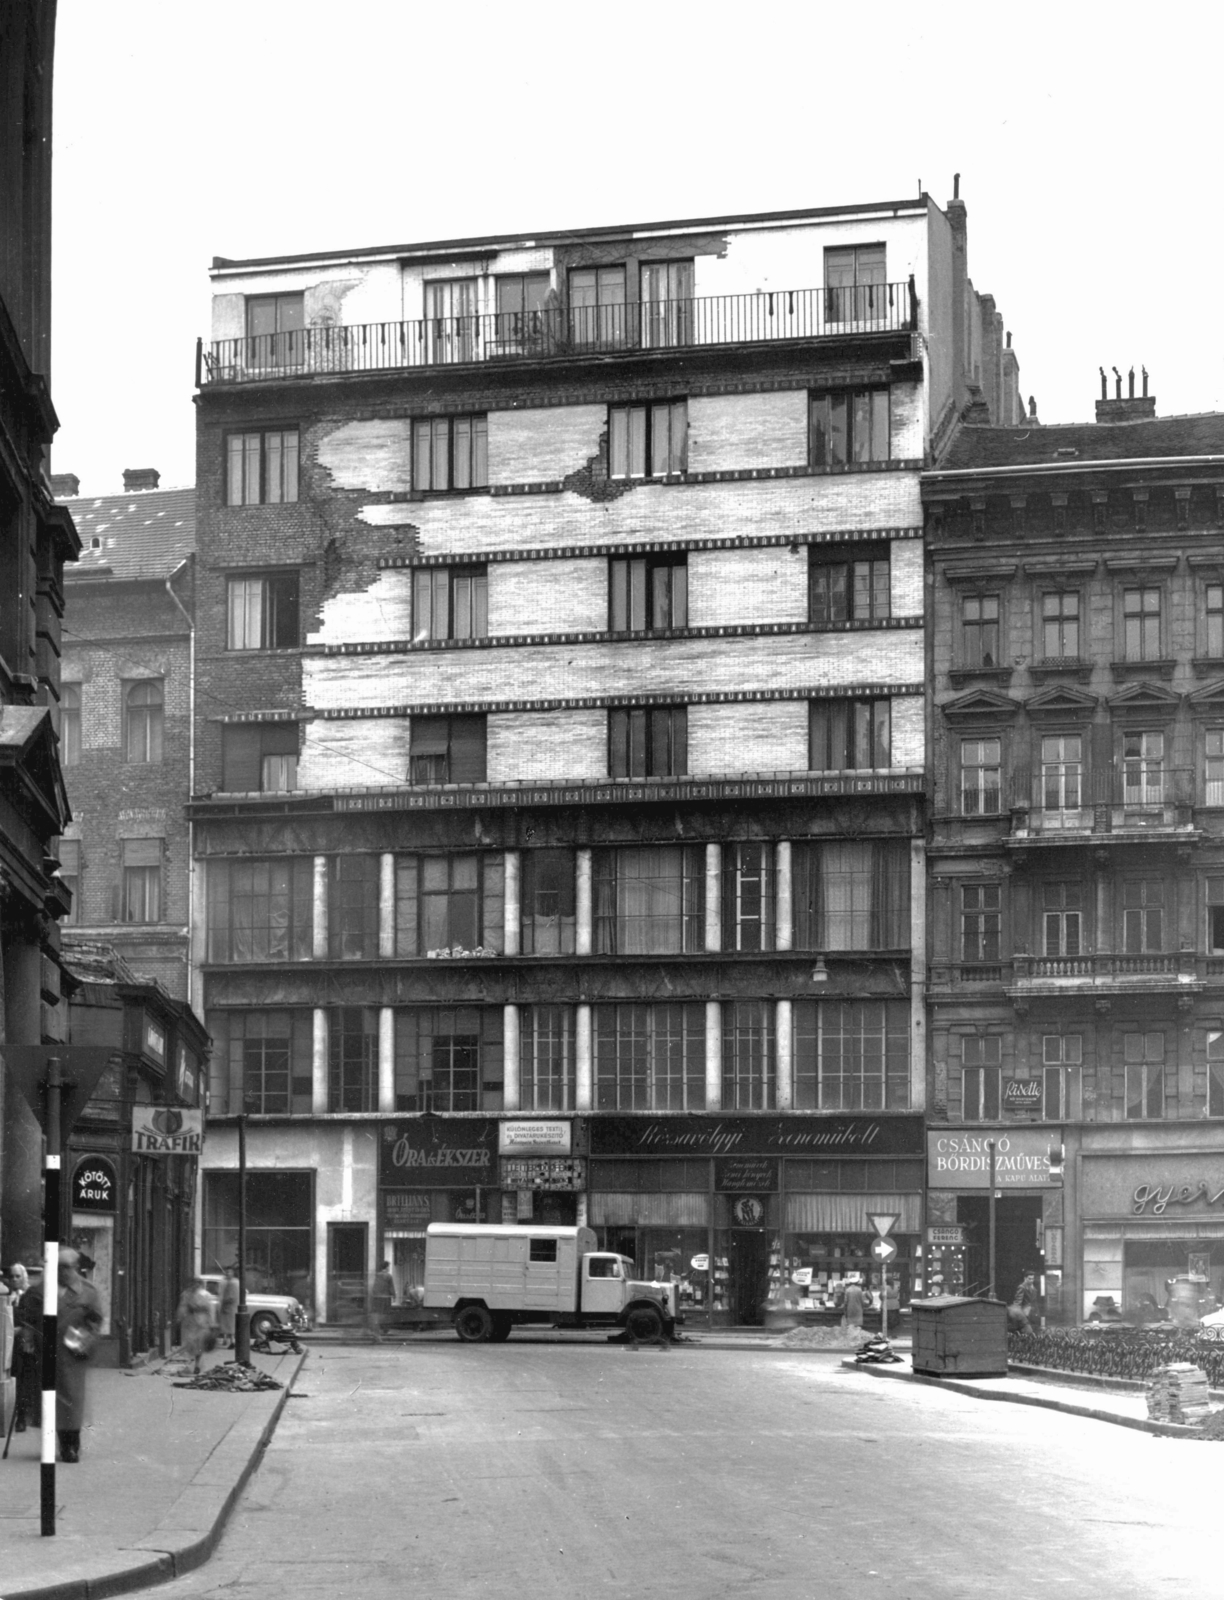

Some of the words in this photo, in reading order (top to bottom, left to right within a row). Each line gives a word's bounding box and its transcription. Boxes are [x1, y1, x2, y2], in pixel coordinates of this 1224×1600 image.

[135, 1130, 201, 1152] TRAFIK
[392, 1133, 427, 1167] ÓRA
[436, 1143, 491, 1167] ÉKSZER
[937, 1133, 1010, 1153] CSÁNGÓ
[79, 1170, 111, 1189] KÖTÖTT
[1005, 1174, 1026, 1182] KAPU
[80, 1188, 109, 1200] ÁRUK
